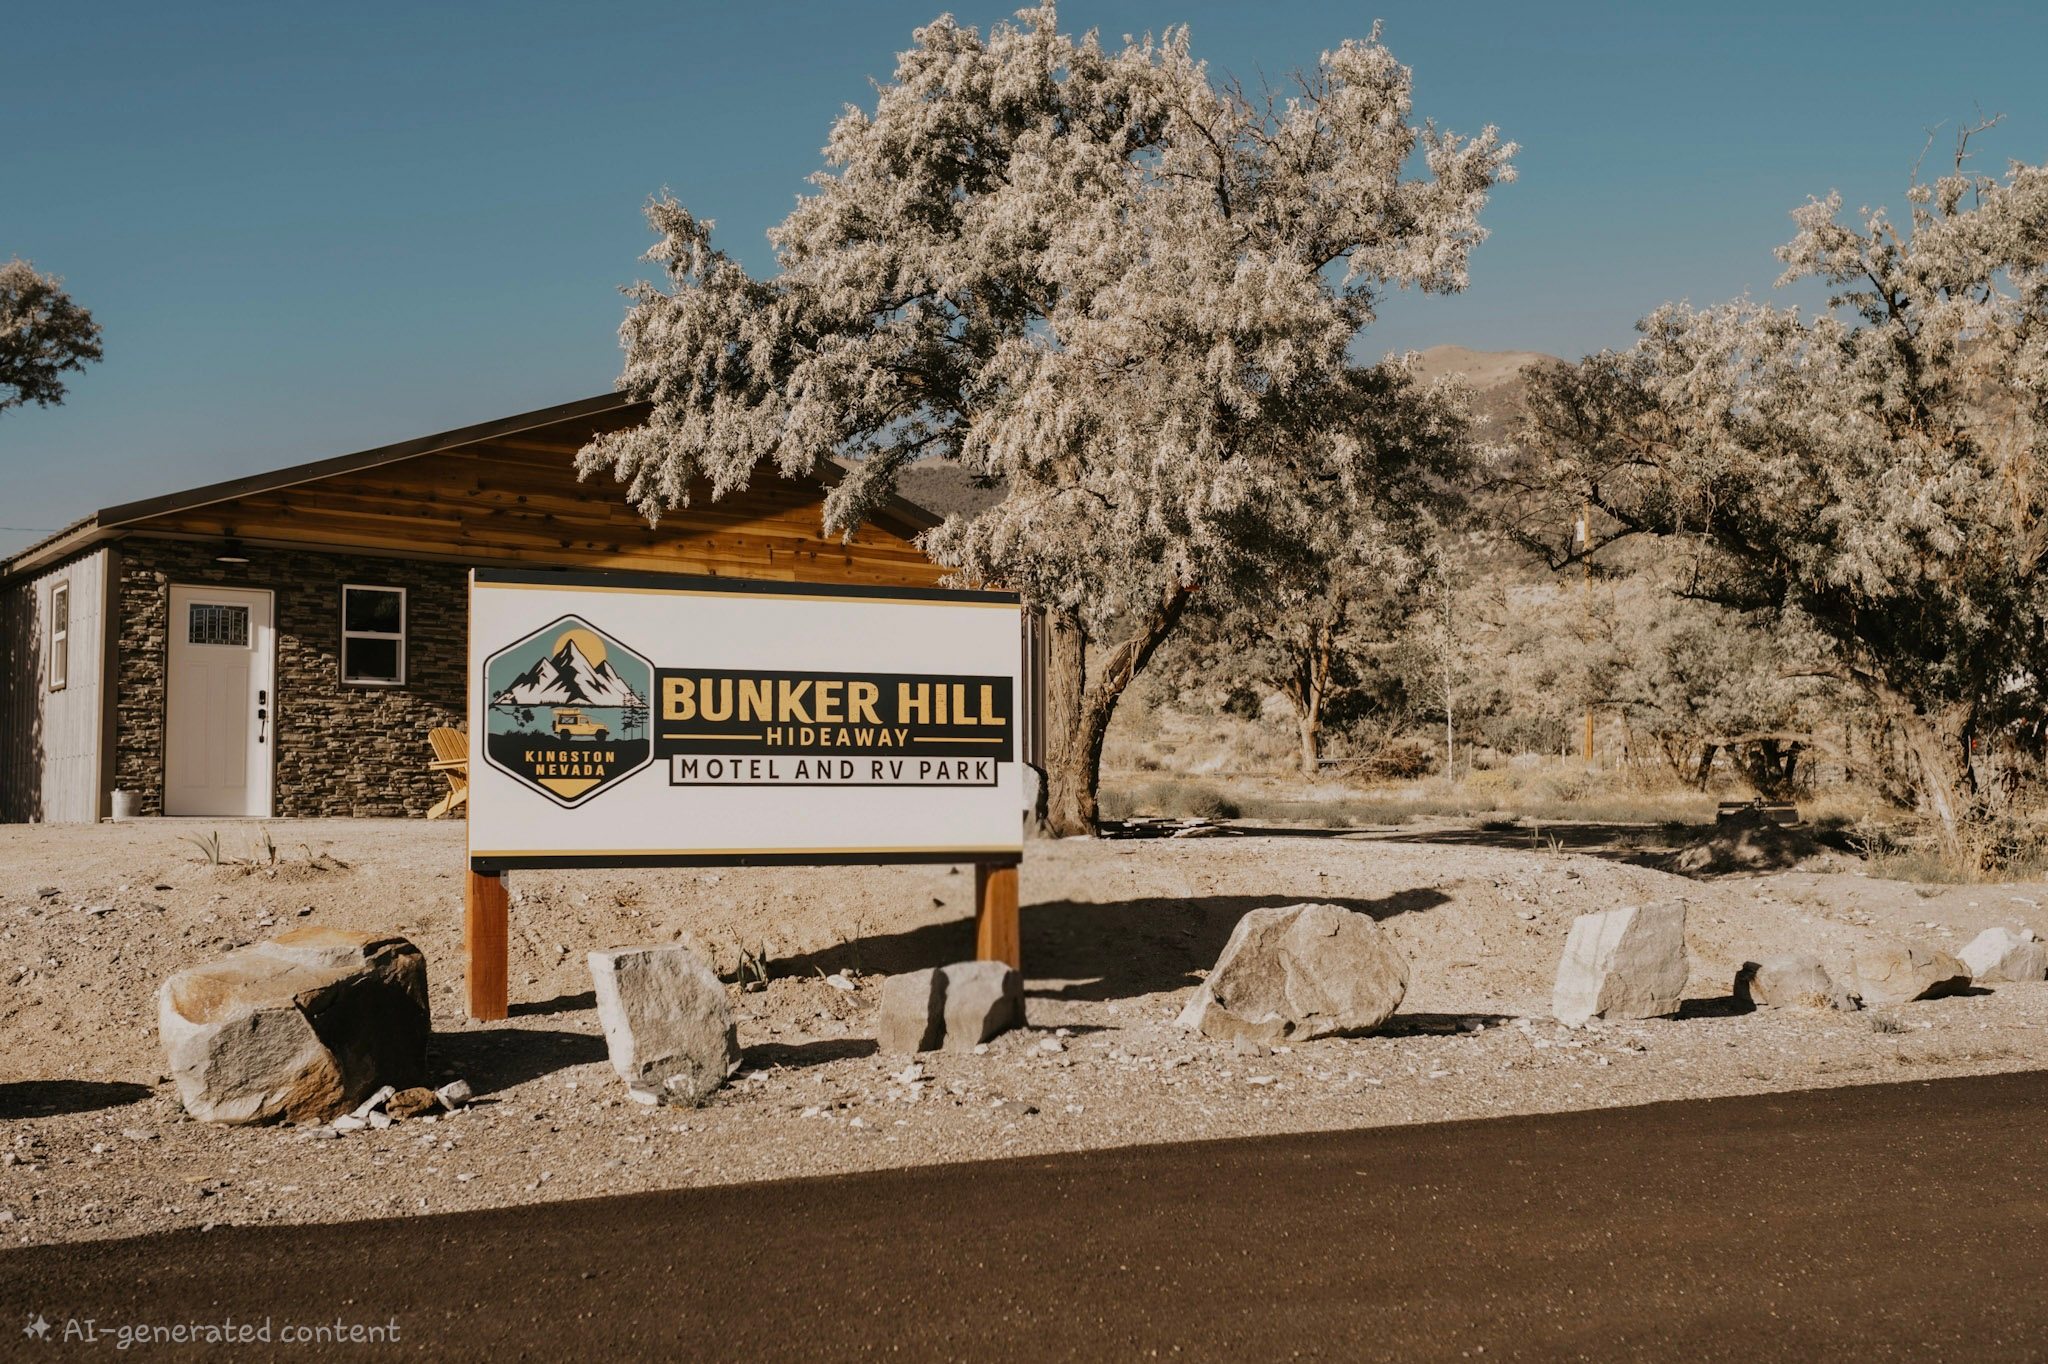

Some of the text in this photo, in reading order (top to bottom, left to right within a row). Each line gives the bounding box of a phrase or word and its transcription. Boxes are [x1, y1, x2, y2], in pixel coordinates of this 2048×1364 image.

[662, 677, 1006, 726] BUNKER HILL
[767, 726, 909, 748] HIDEAWAY
[525, 750, 615, 763] KINGSTON
[536, 764, 605, 776] NEVADA
[681, 758, 990, 780] MOTEL AND RV PARK
